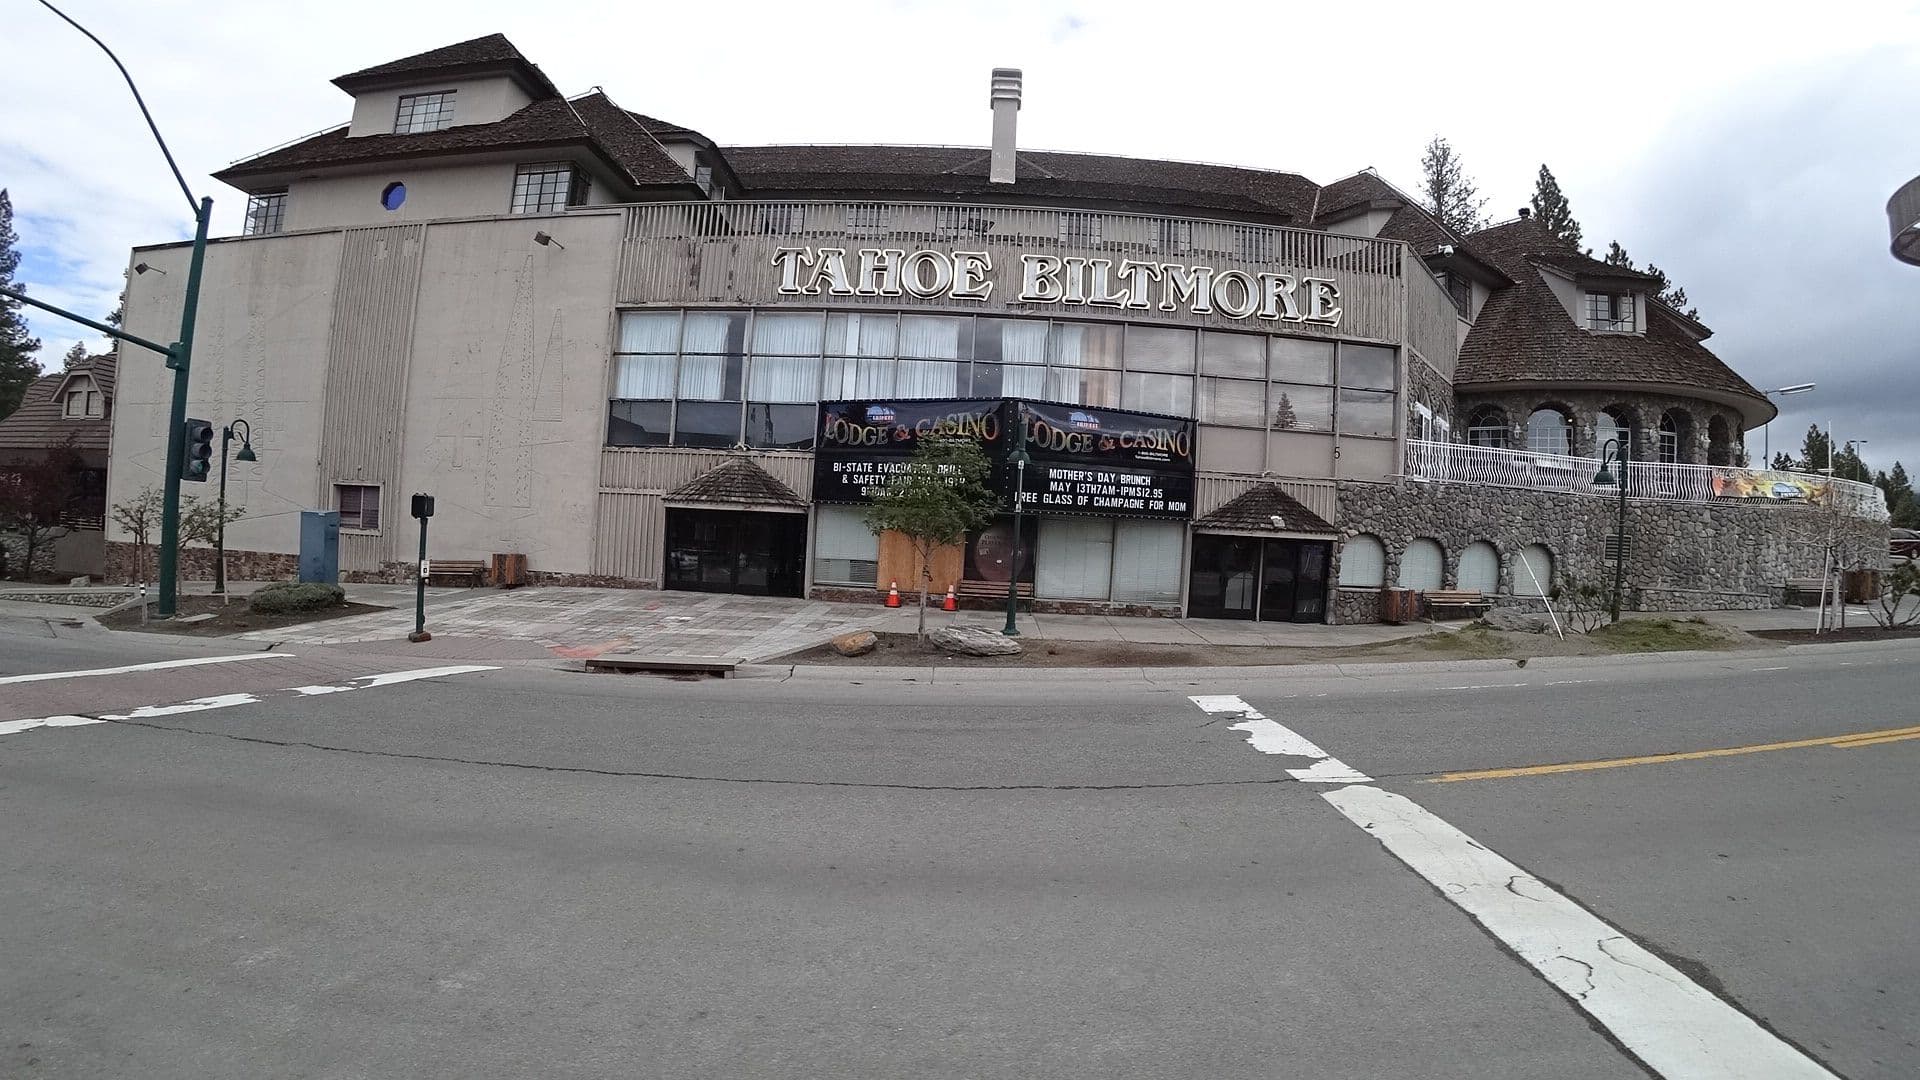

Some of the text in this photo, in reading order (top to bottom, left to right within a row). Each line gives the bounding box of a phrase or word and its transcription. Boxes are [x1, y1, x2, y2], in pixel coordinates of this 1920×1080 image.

[771, 246, 1343, 328] TAHOE BILTMORE
[825, 411, 999, 446] LODGE & CASINO
[1098, 434, 1116, 451] &
[1119, 428, 1191, 458] CASINO
[1334, 446, 1341, 459] 5
[833, 462, 873, 473] BI-STATE
[842, 474, 849, 484] &
[853, 475, 886, 485] SAFETY
[1049, 468, 1151, 487] MOTHER'S DAY BRUNCH
[1050, 481, 1071, 493] MAY
[1043, 493, 1073, 505] GLASS
[1077, 495, 1089, 506] OF
[1093, 496, 1145, 509] CHAMPAGNE
[1149, 500, 1164, 511] FOR
[1168, 501, 1187, 512] MOM
